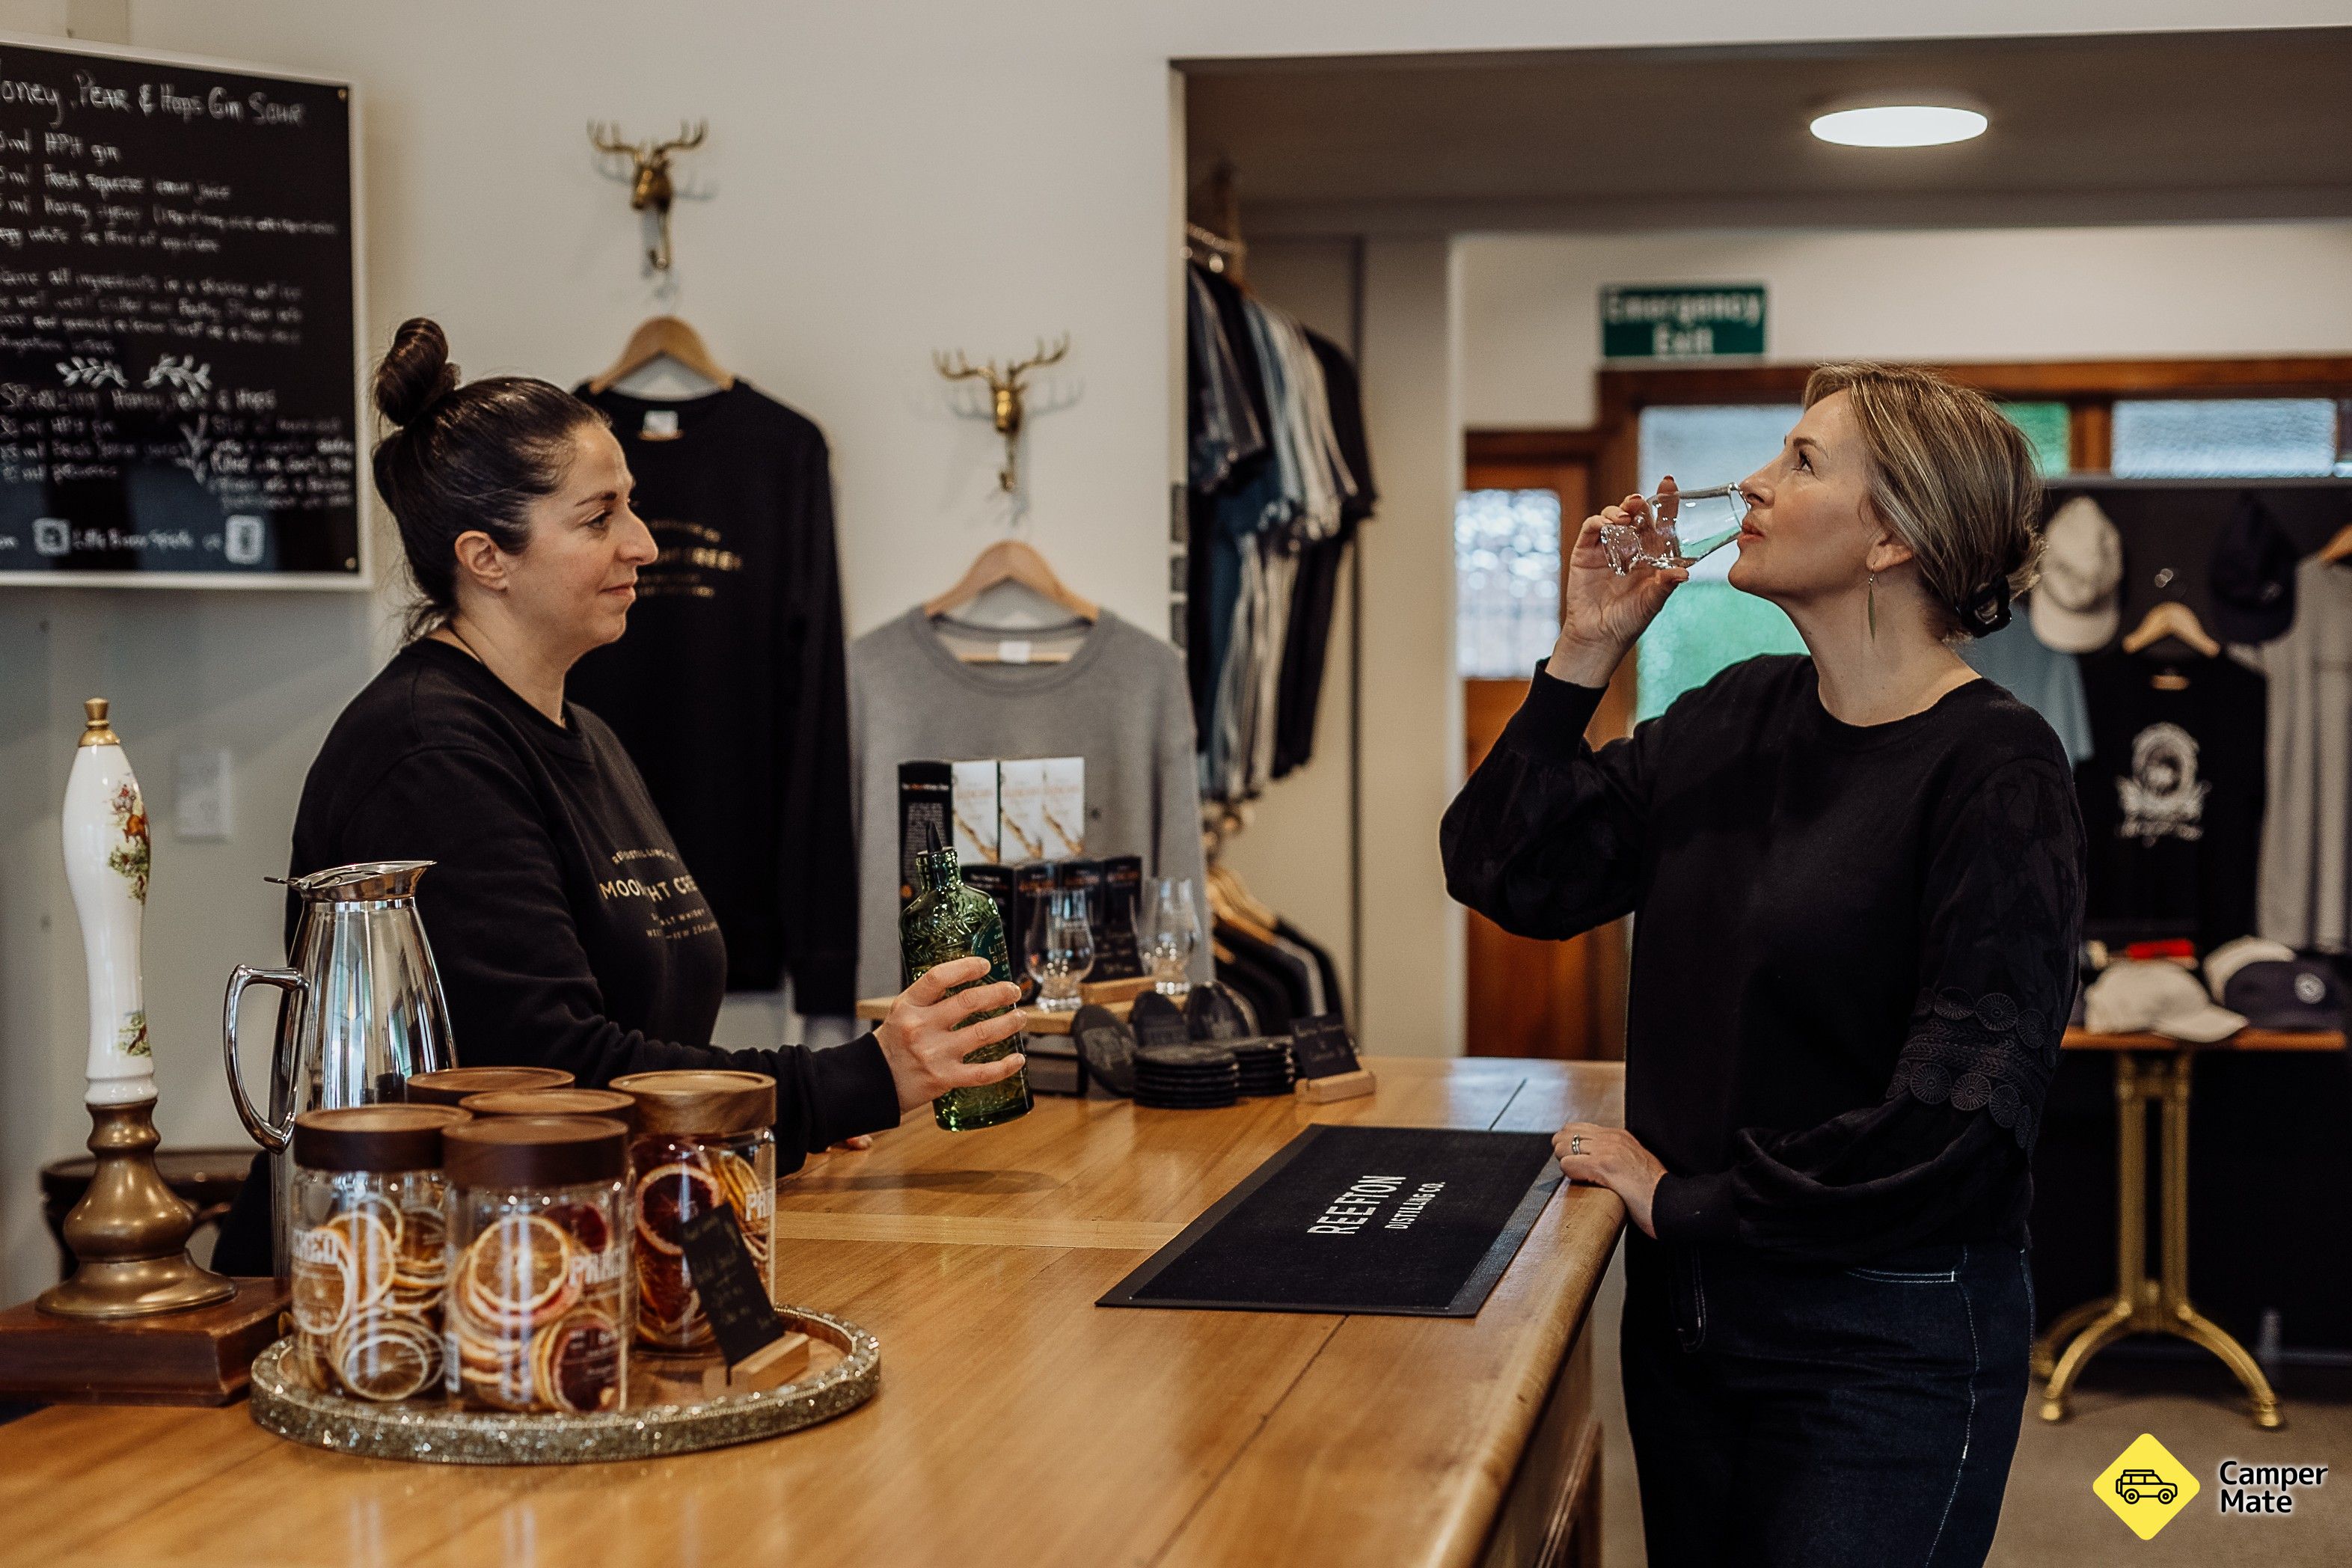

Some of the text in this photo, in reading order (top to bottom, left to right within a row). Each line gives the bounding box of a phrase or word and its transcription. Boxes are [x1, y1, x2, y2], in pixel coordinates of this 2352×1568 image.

[160, 82, 205, 123] Hops
[208, 86, 244, 120] Gin
[248, 91, 305, 126] Sour
[1307, 1175, 1406, 1234] REEFTON
[1384, 1192, 1436, 1229] DISTILLING
